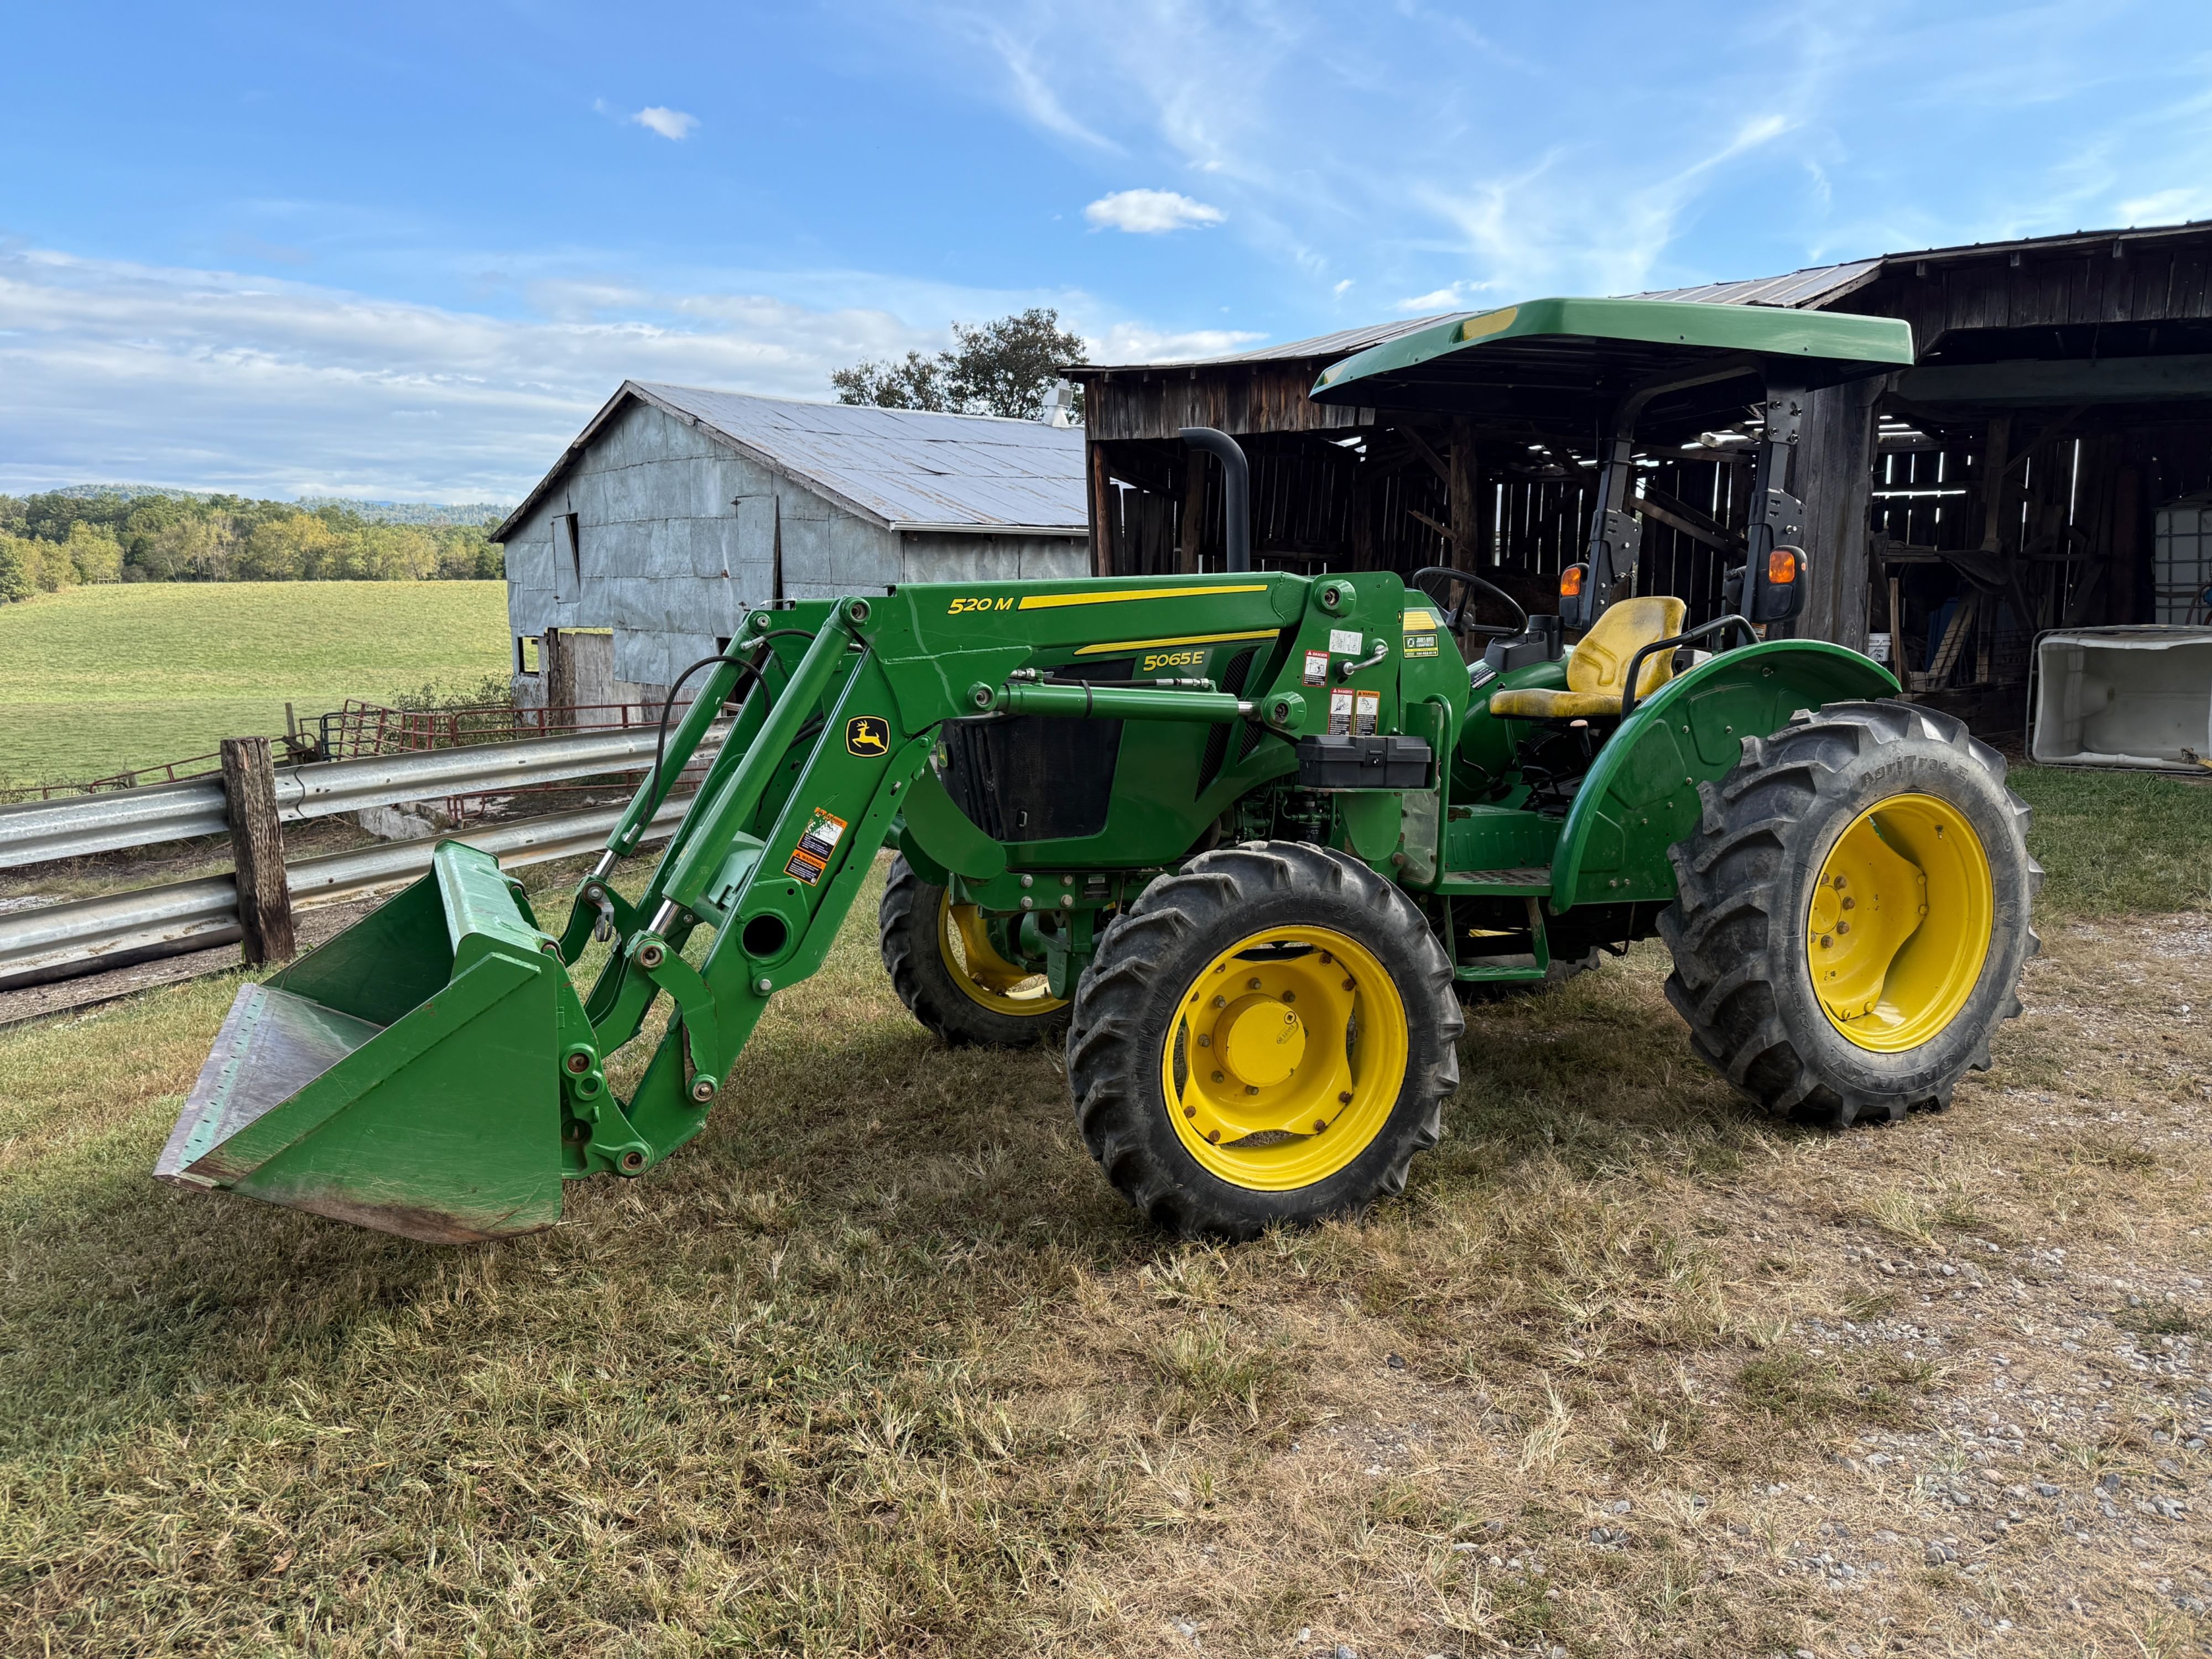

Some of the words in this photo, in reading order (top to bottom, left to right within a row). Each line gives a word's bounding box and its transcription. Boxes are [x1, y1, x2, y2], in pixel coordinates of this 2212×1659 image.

[947, 598, 992, 614] 520
[994, 597, 1014, 611] M
[1143, 651, 1205, 671] 5065E
[1861, 754, 1949, 789] AgriTrac
[801, 854, 823, 868] WARNING
[1285, 896, 1363, 925] 9.5-24
[1830, 1053, 1957, 1091] GALAXY
